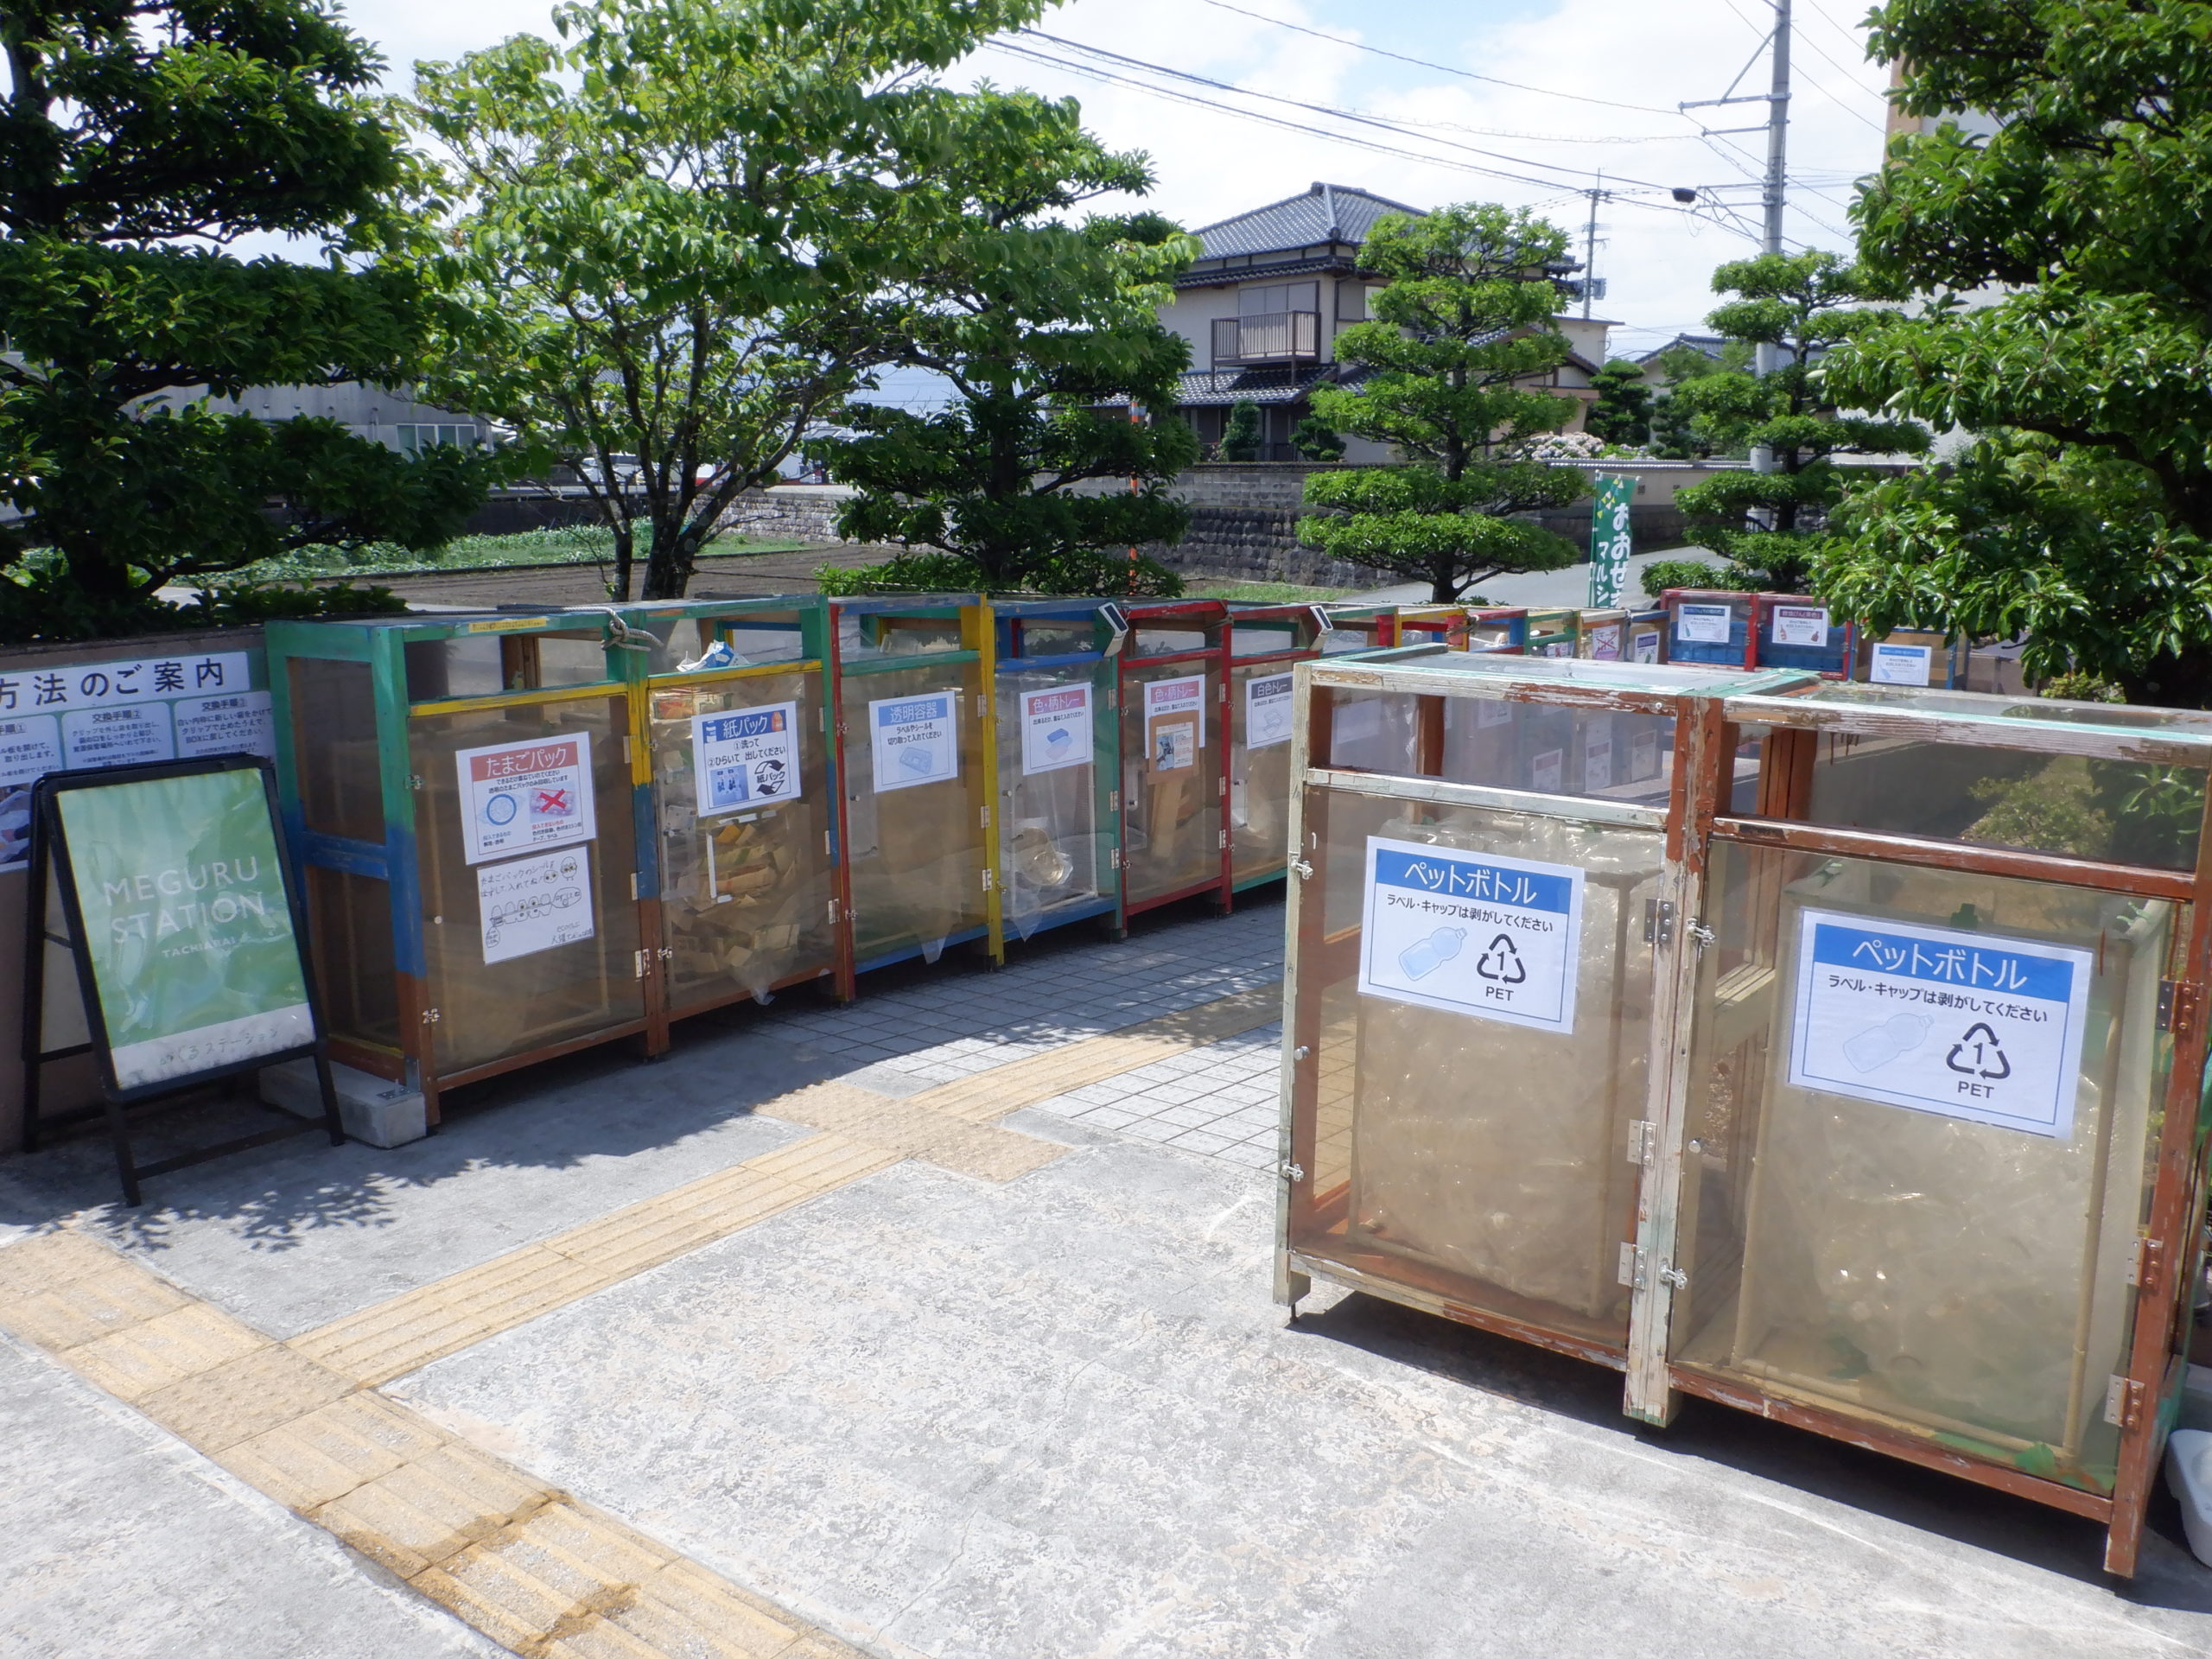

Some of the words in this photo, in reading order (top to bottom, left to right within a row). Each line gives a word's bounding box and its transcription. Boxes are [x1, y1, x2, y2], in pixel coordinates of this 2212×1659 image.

[1596, 541, 1609, 604] マルシ
[0, 658, 224, 709] 方法のご案内
[1154, 683, 1195, 702] 色・柄トレー
[1257, 681, 1287, 696] 白色トレー
[890, 702, 938, 723] 透明容器
[1033, 694, 1079, 713] 色・柄トレー
[722, 715, 768, 739] 紙パック
[486, 747, 567, 778] たまごパック
[708, 753, 741, 767] ②ひらいて
[745, 746, 785, 761] 出してください
[756, 771, 785, 784] 紙パック
[103, 855, 259, 906] MEGURU
[1404, 861, 1537, 904] ペットボトル
[110, 890, 266, 944] STATION
[1387, 893, 1554, 932] ラベル・キャップは剥がしてください
[162, 936, 237, 958] TACHIARAI
[1497, 951, 1505, 971] 1
[1852, 939, 2028, 990] ペットボトル
[1485, 986, 1514, 1001] PET
[1828, 974, 2048, 1023] ラベル・キャップは剥がしてください
[1973, 1042, 1983, 1065] 1
[1958, 1080, 1994, 1099] PET
